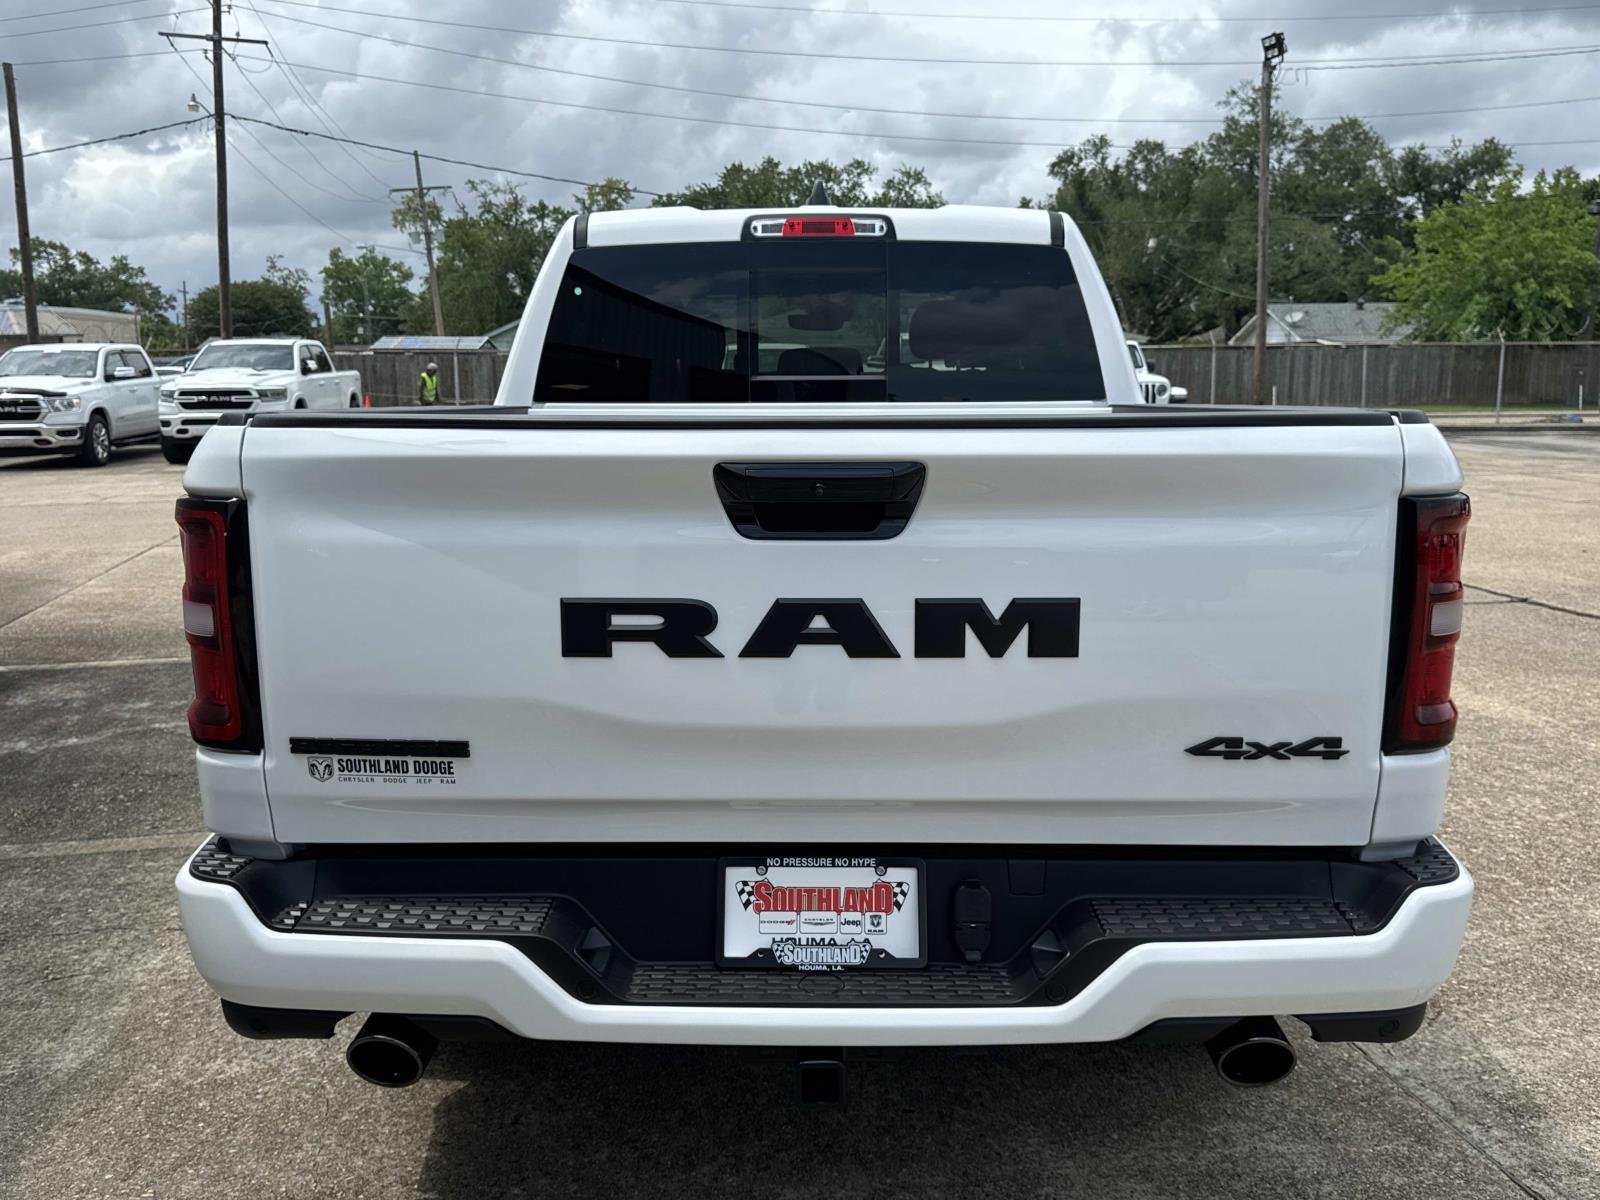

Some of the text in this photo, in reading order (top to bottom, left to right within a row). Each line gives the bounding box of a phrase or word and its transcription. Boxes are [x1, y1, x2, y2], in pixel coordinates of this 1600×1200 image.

[560, 597, 1080, 658] RAM
[338, 758, 455, 775] SOUTHLAND DODGE
[766, 857, 876, 866] NO PRESSURE NO HYPE
[753, 881, 894, 914] SOUTHLAND
[840, 918, 861, 927] Jeep
[783, 944, 861, 963] SOUTHLAND
